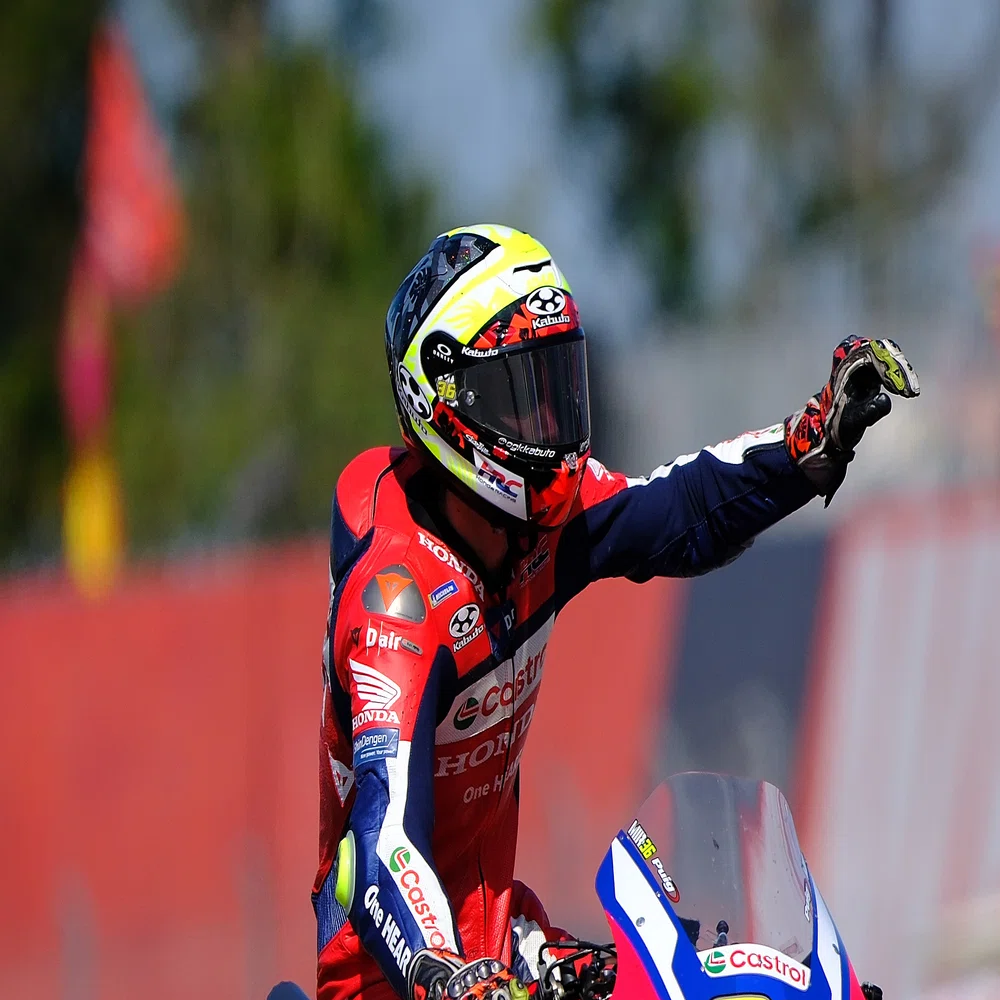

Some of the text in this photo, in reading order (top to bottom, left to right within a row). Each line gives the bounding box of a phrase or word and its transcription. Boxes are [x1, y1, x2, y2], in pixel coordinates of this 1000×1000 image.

[532, 314, 570, 330] Kabuto
[461, 346, 499, 358] Kabuto
[436, 380, 456, 400] 36
[477, 460, 523, 498] HRC
[417, 532, 486, 602] HONDA
[452, 624, 485, 653] Kabuto
[481, 643, 548, 717] Castr
[352, 709, 401, 731] HONDA
[434, 703, 535, 777] HOND
[463, 783, 490, 804] One
[651, 857, 677, 893] Puig
[400, 869, 447, 950] Castro
[364, 884, 412, 977] One HEAR
[729, 949, 807, 987] Castrol
